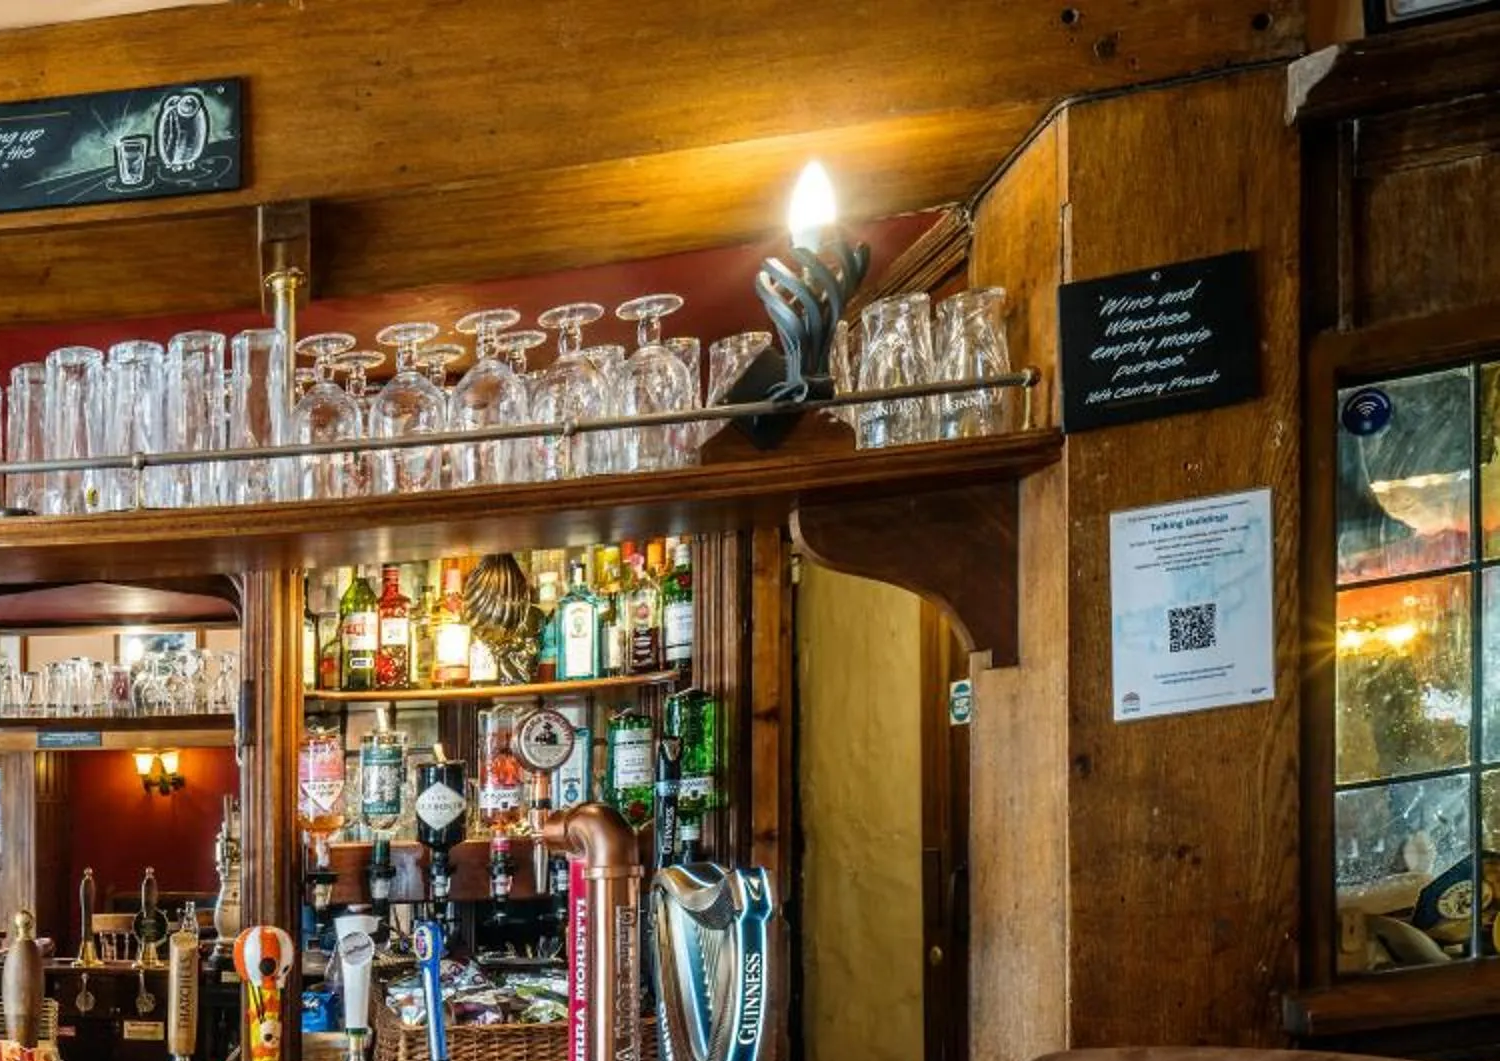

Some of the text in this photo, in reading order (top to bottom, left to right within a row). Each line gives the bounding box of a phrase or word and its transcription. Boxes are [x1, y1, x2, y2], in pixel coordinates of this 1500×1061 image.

[19, 129, 44, 145] up
[6, 145, 36, 160] the
[1158, 280, 1202, 306] and
[1090, 337, 1156, 361] empty
[1150, 520, 1184, 534] Talking
[575, 897, 588, 1001] MORETTI
[737, 952, 761, 1045] GUINNESS
